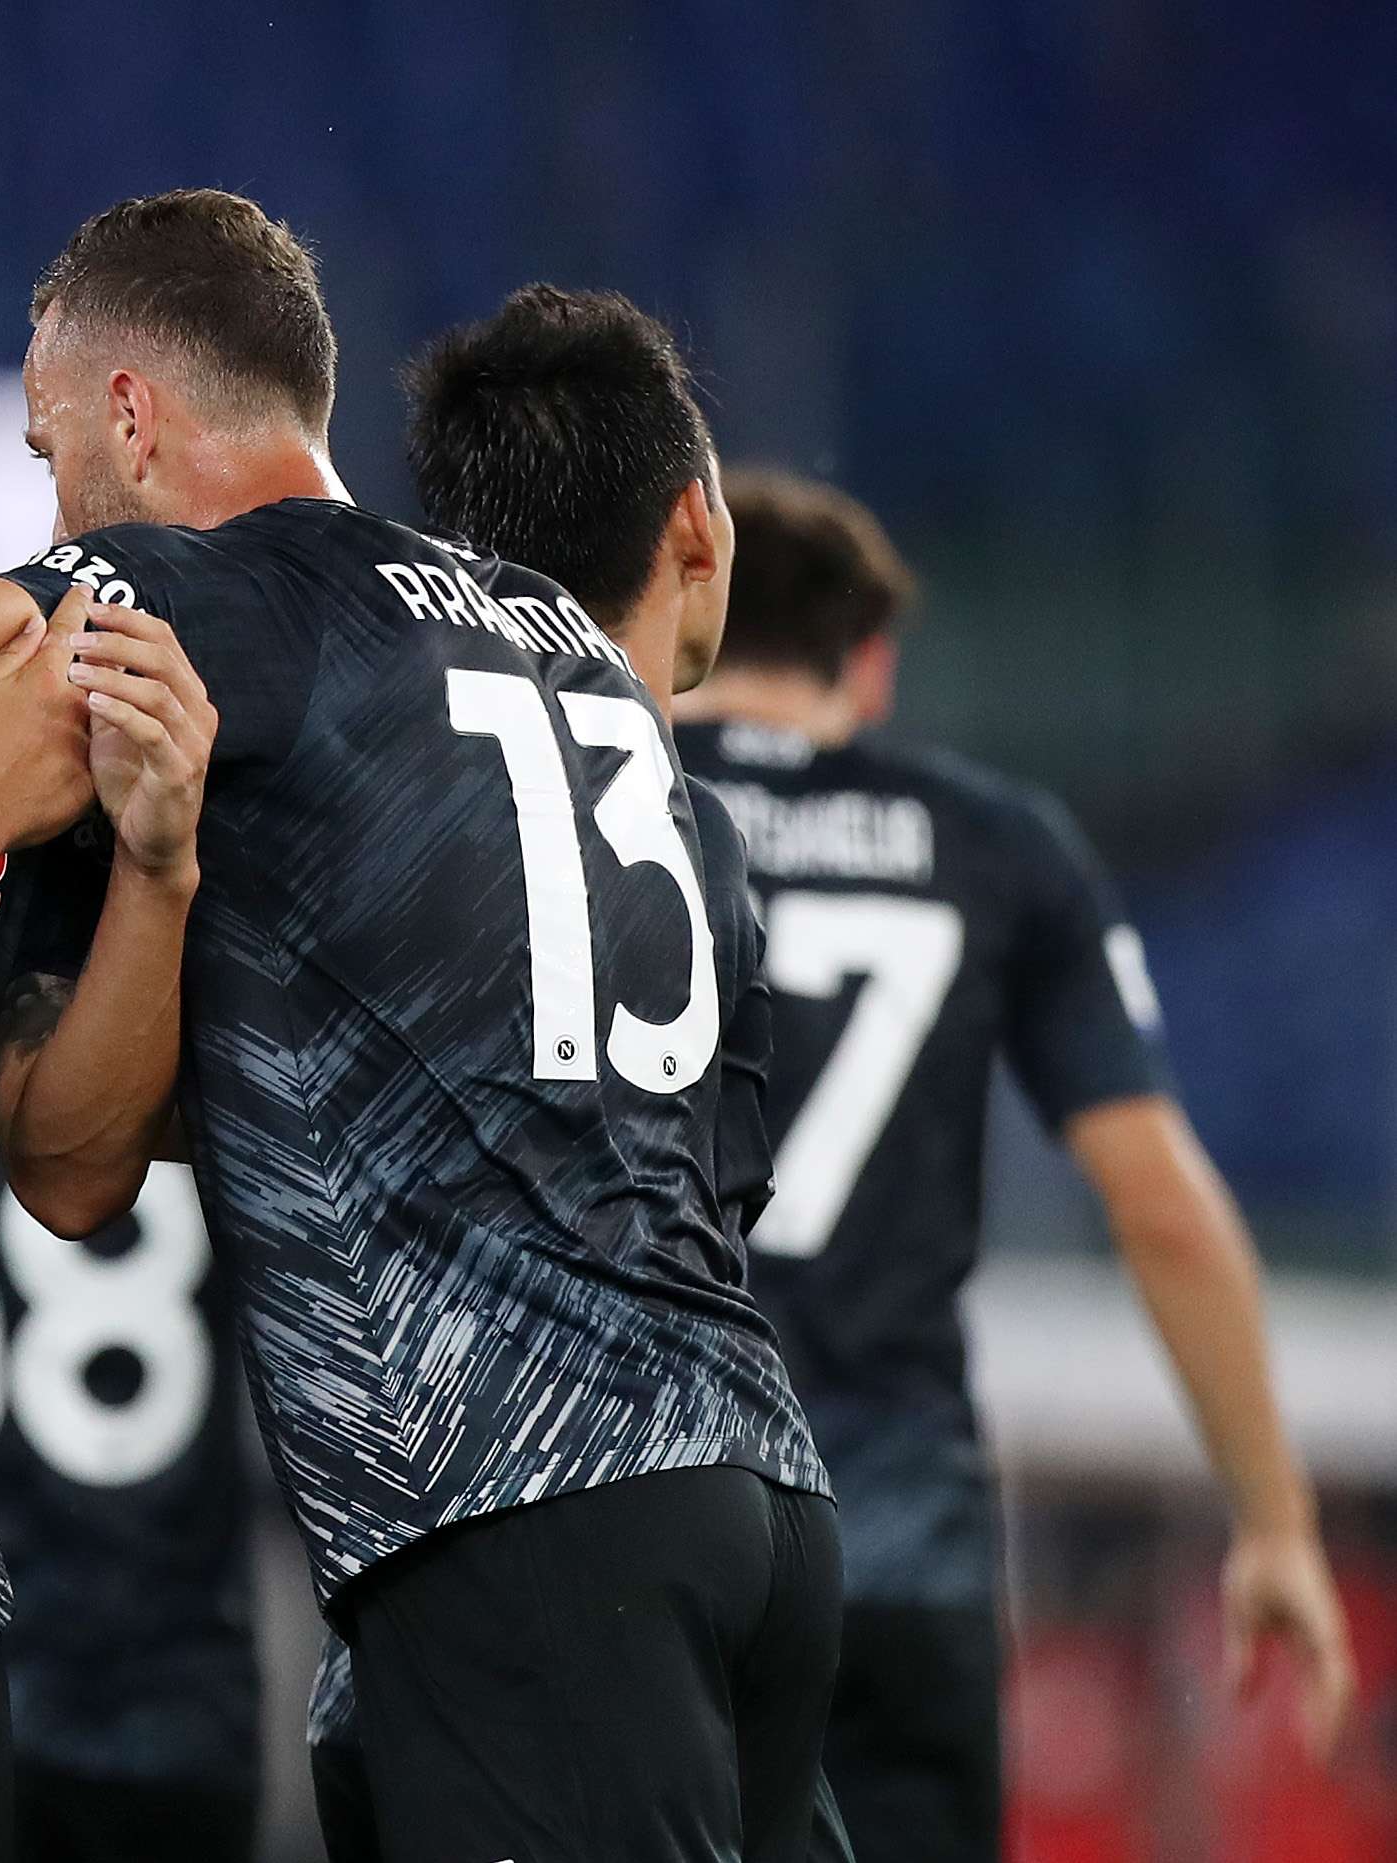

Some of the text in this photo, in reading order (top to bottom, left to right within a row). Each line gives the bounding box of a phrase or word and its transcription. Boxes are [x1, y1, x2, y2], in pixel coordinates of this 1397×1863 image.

[27, 545, 146, 615] azo
[444, 667, 720, 1094] 13
[747, 889, 964, 1260] 7
